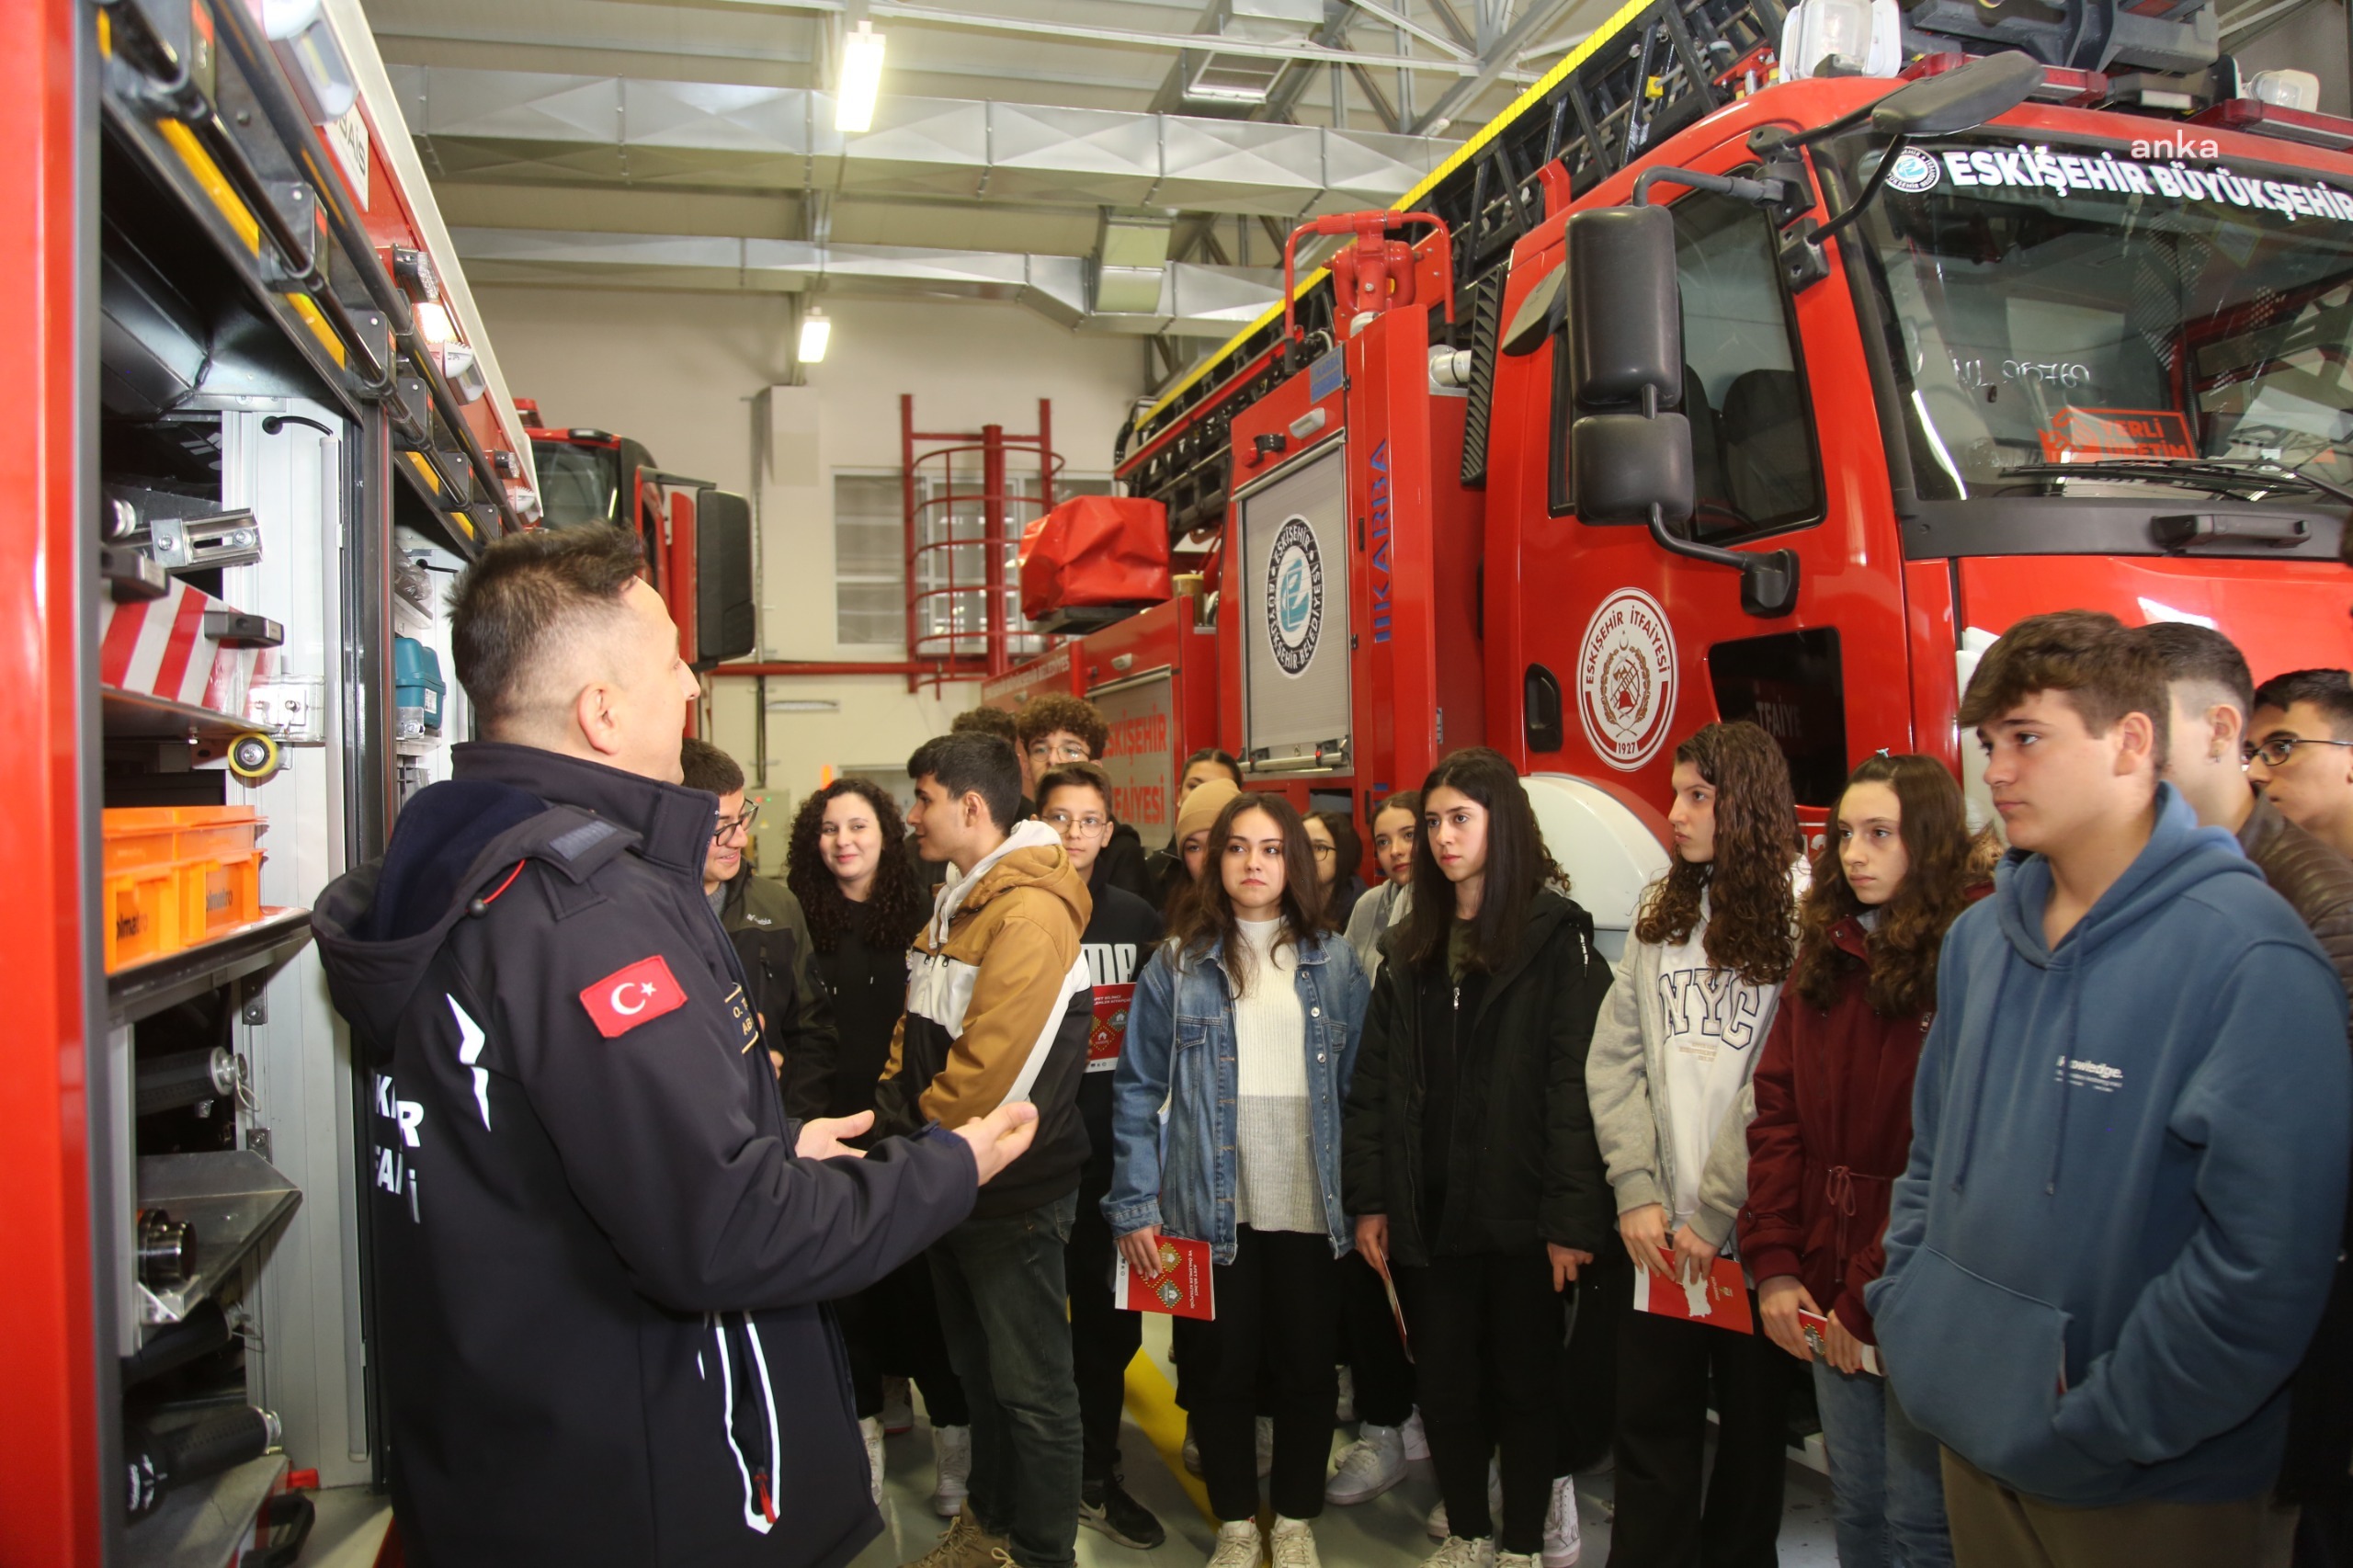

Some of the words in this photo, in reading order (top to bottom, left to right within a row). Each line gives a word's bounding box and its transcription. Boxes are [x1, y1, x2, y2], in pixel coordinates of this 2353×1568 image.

[1942, 143, 2155, 197] ESKİŞEHİR
[2148, 160, 2353, 222] BÜYÜKŞEHİR
[1274, 525, 1312, 564] ESKİŞEHİR
[1586, 609, 1624, 685] ESKİŞEHİR
[1630, 605, 1671, 674] İTFAİYESİ
[1102, 702, 1167, 767] SKİŞEHİR
[1618, 742, 1636, 755] 1927
[1113, 774, 1165, 824] FAİYESİ
[1658, 968, 1760, 1051] NYC
